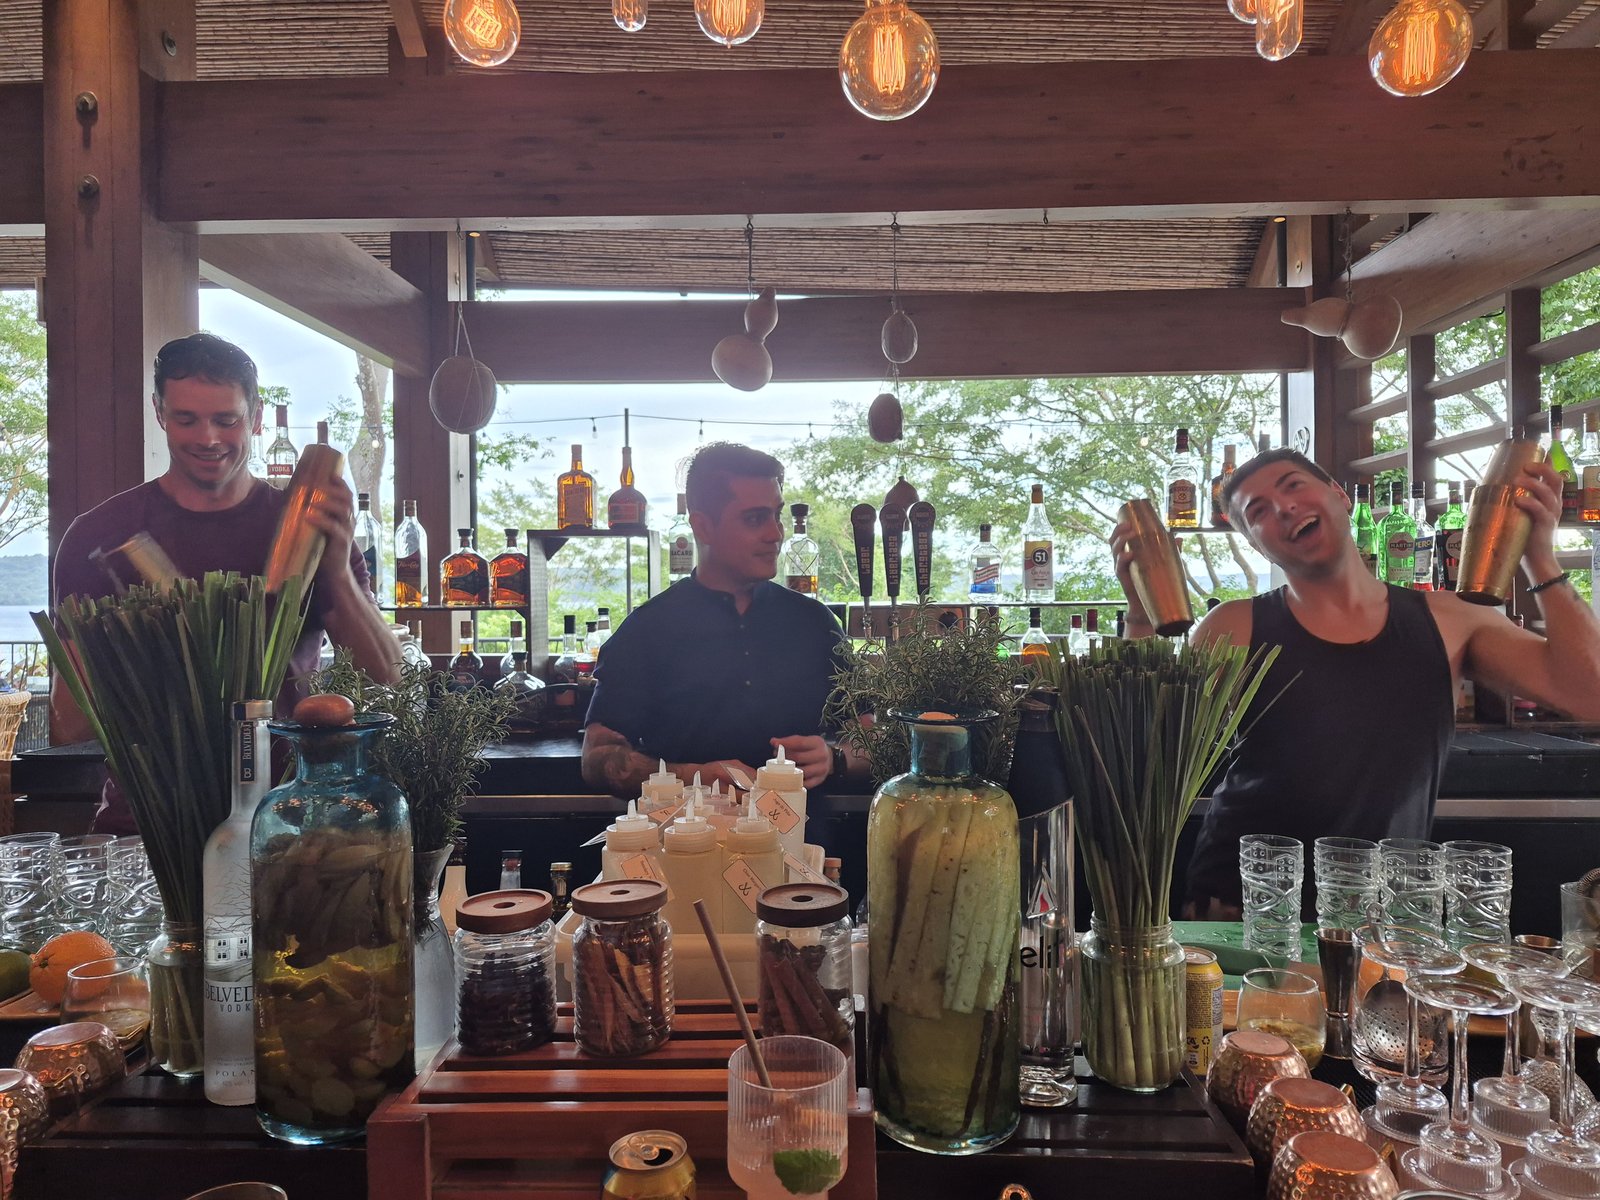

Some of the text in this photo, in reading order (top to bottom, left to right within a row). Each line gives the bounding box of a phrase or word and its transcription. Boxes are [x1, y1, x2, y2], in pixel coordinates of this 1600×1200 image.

[1034, 552, 1047, 563] 51
[205, 984, 254, 1003] BELVED
[219, 1002, 251, 1013] VODK
